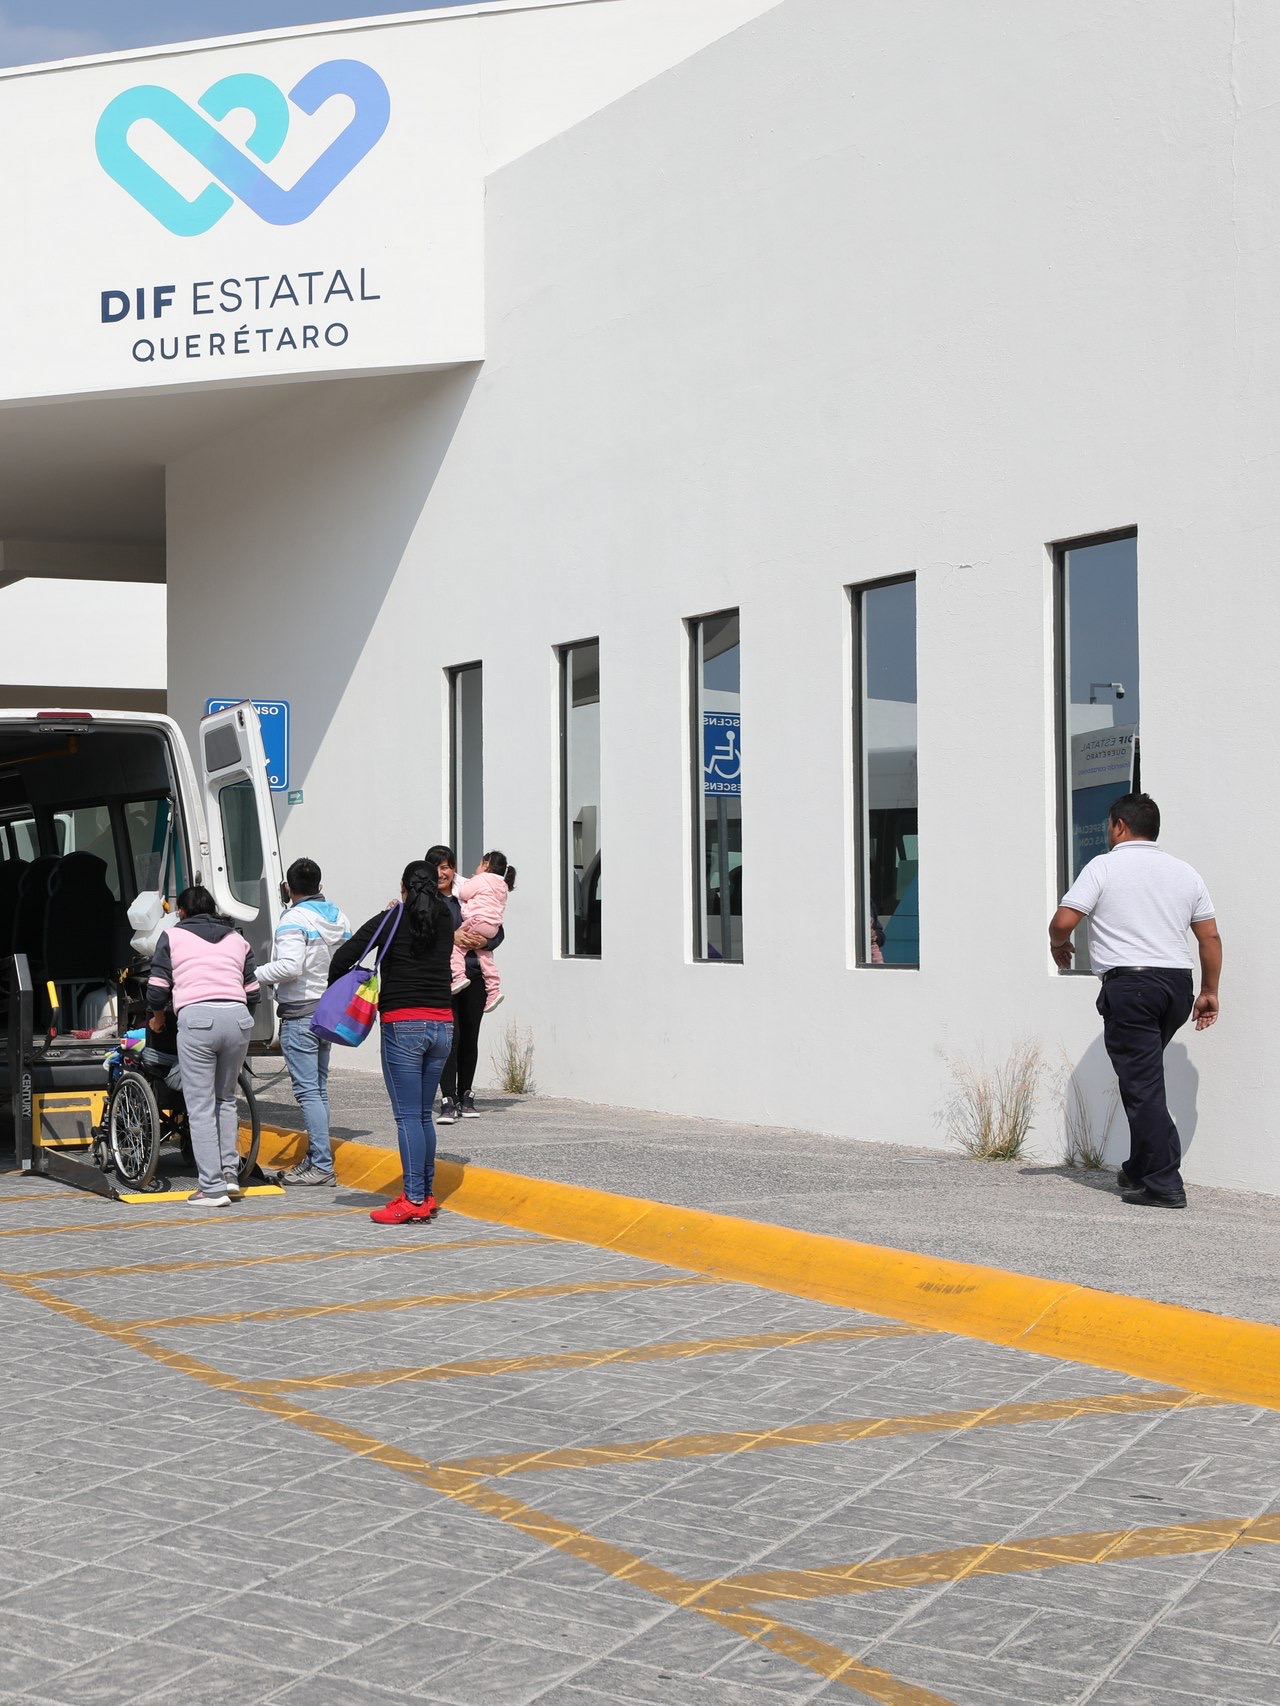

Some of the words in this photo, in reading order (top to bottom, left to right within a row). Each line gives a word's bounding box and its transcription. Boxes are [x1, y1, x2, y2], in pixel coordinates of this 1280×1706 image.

[101, 285, 175, 324] DIF
[193, 267, 381, 315] ESTATAL
[131, 322, 349, 363] QUERÉTARO
[22, 1073, 31, 1118] CENTURY
